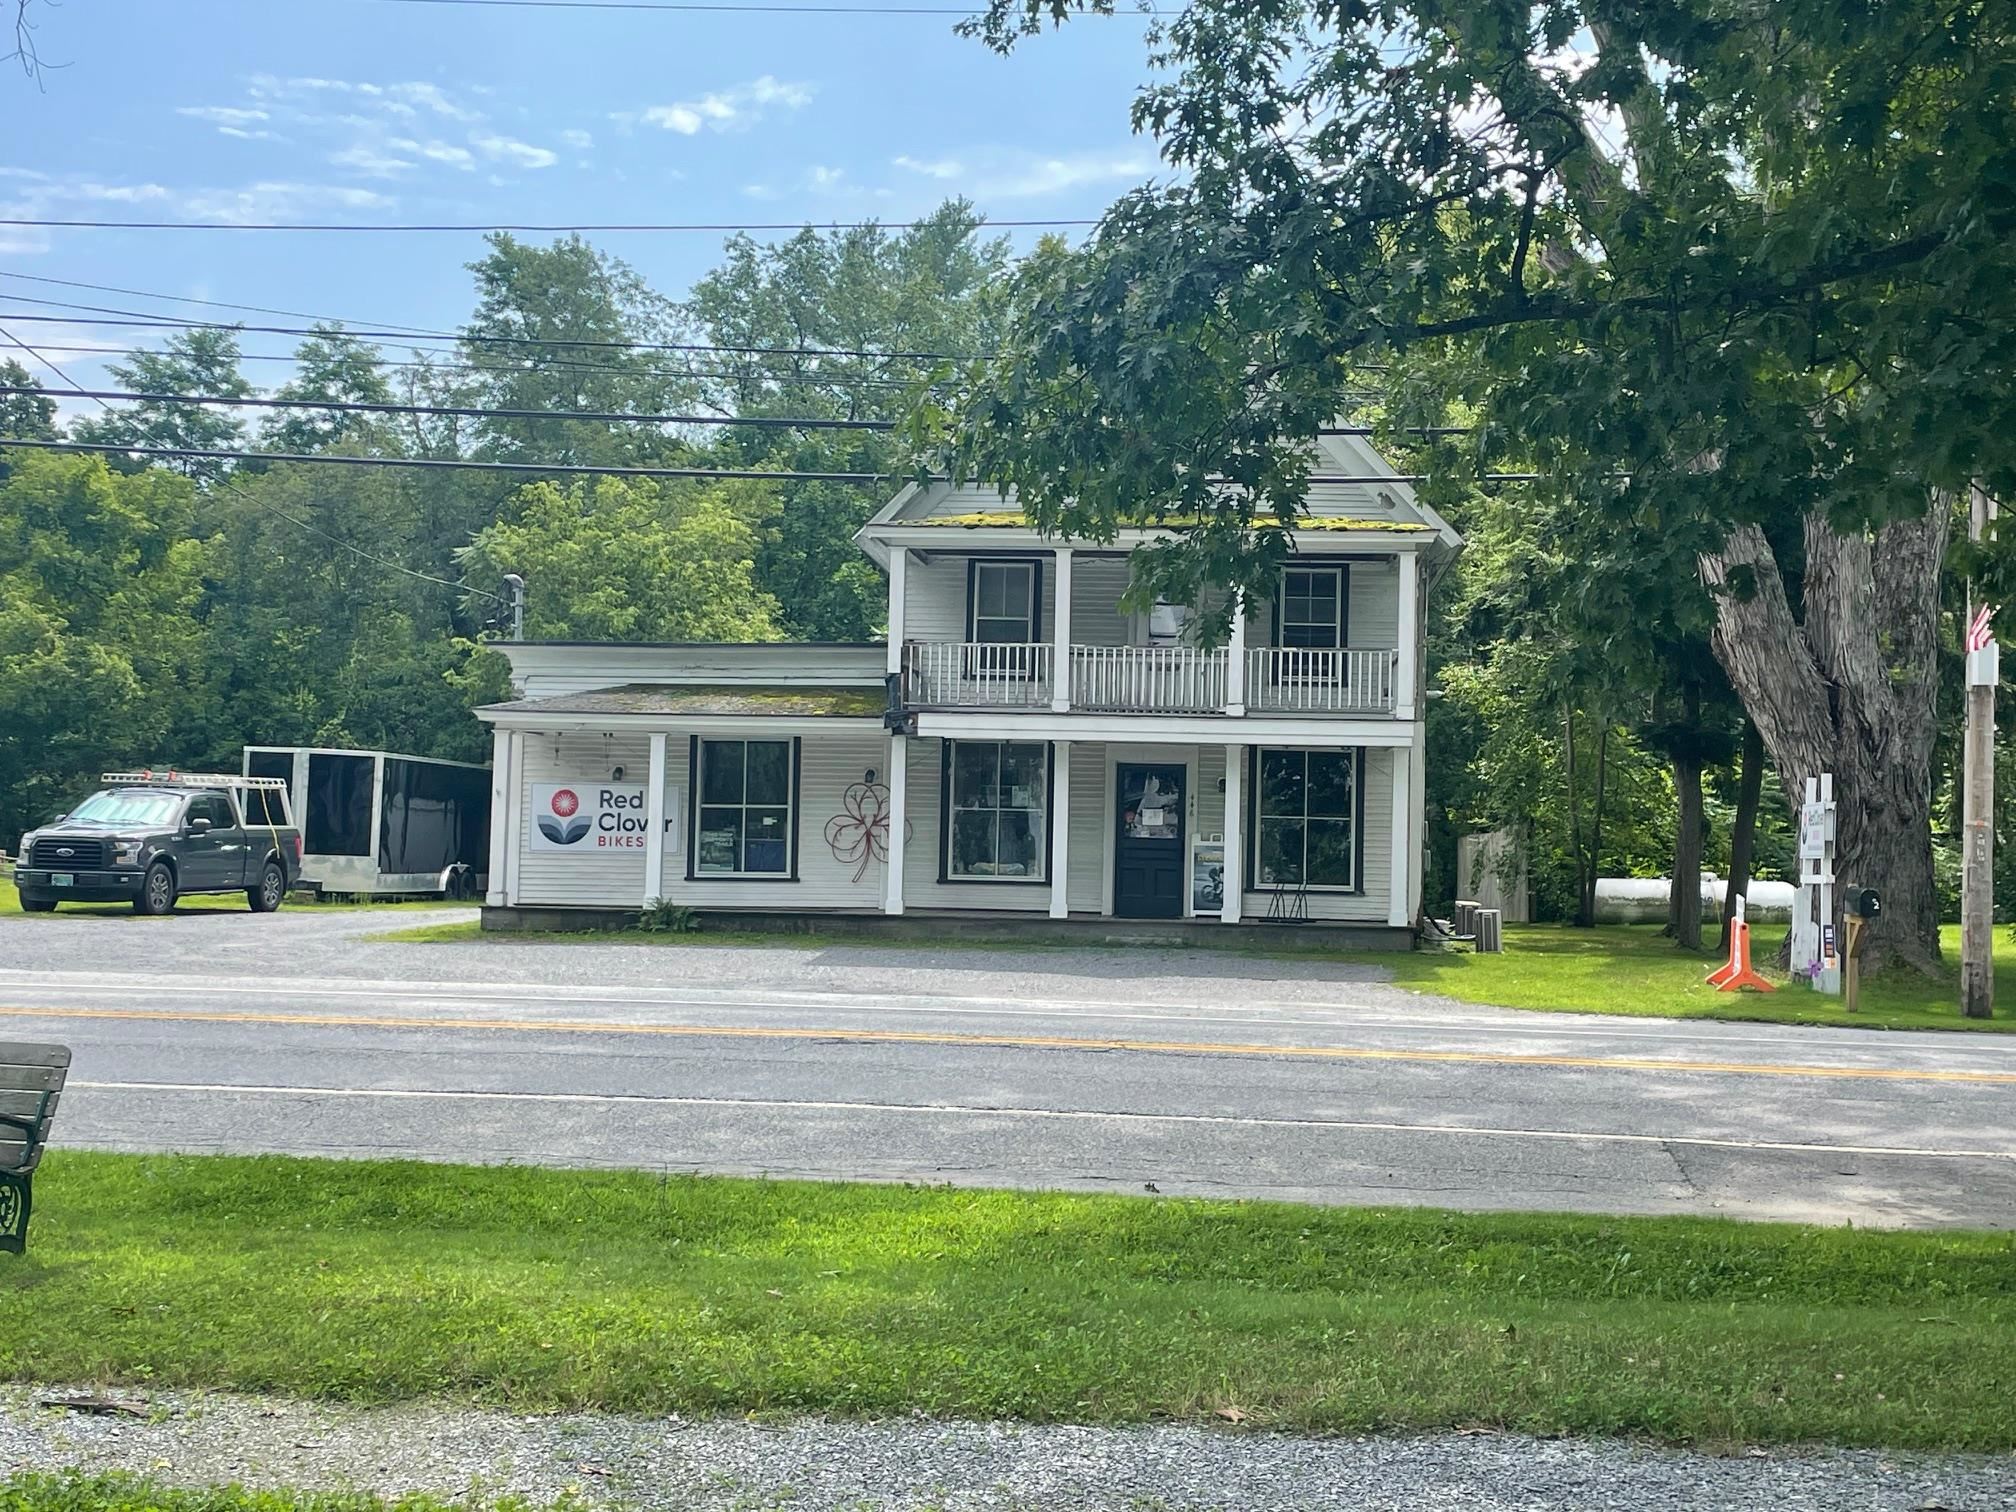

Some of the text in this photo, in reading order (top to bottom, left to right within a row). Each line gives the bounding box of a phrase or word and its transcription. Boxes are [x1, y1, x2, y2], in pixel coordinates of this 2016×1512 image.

[600, 789, 644, 809] Red
[598, 812, 673, 833] Clovr
[598, 836, 644, 848] BIKES
